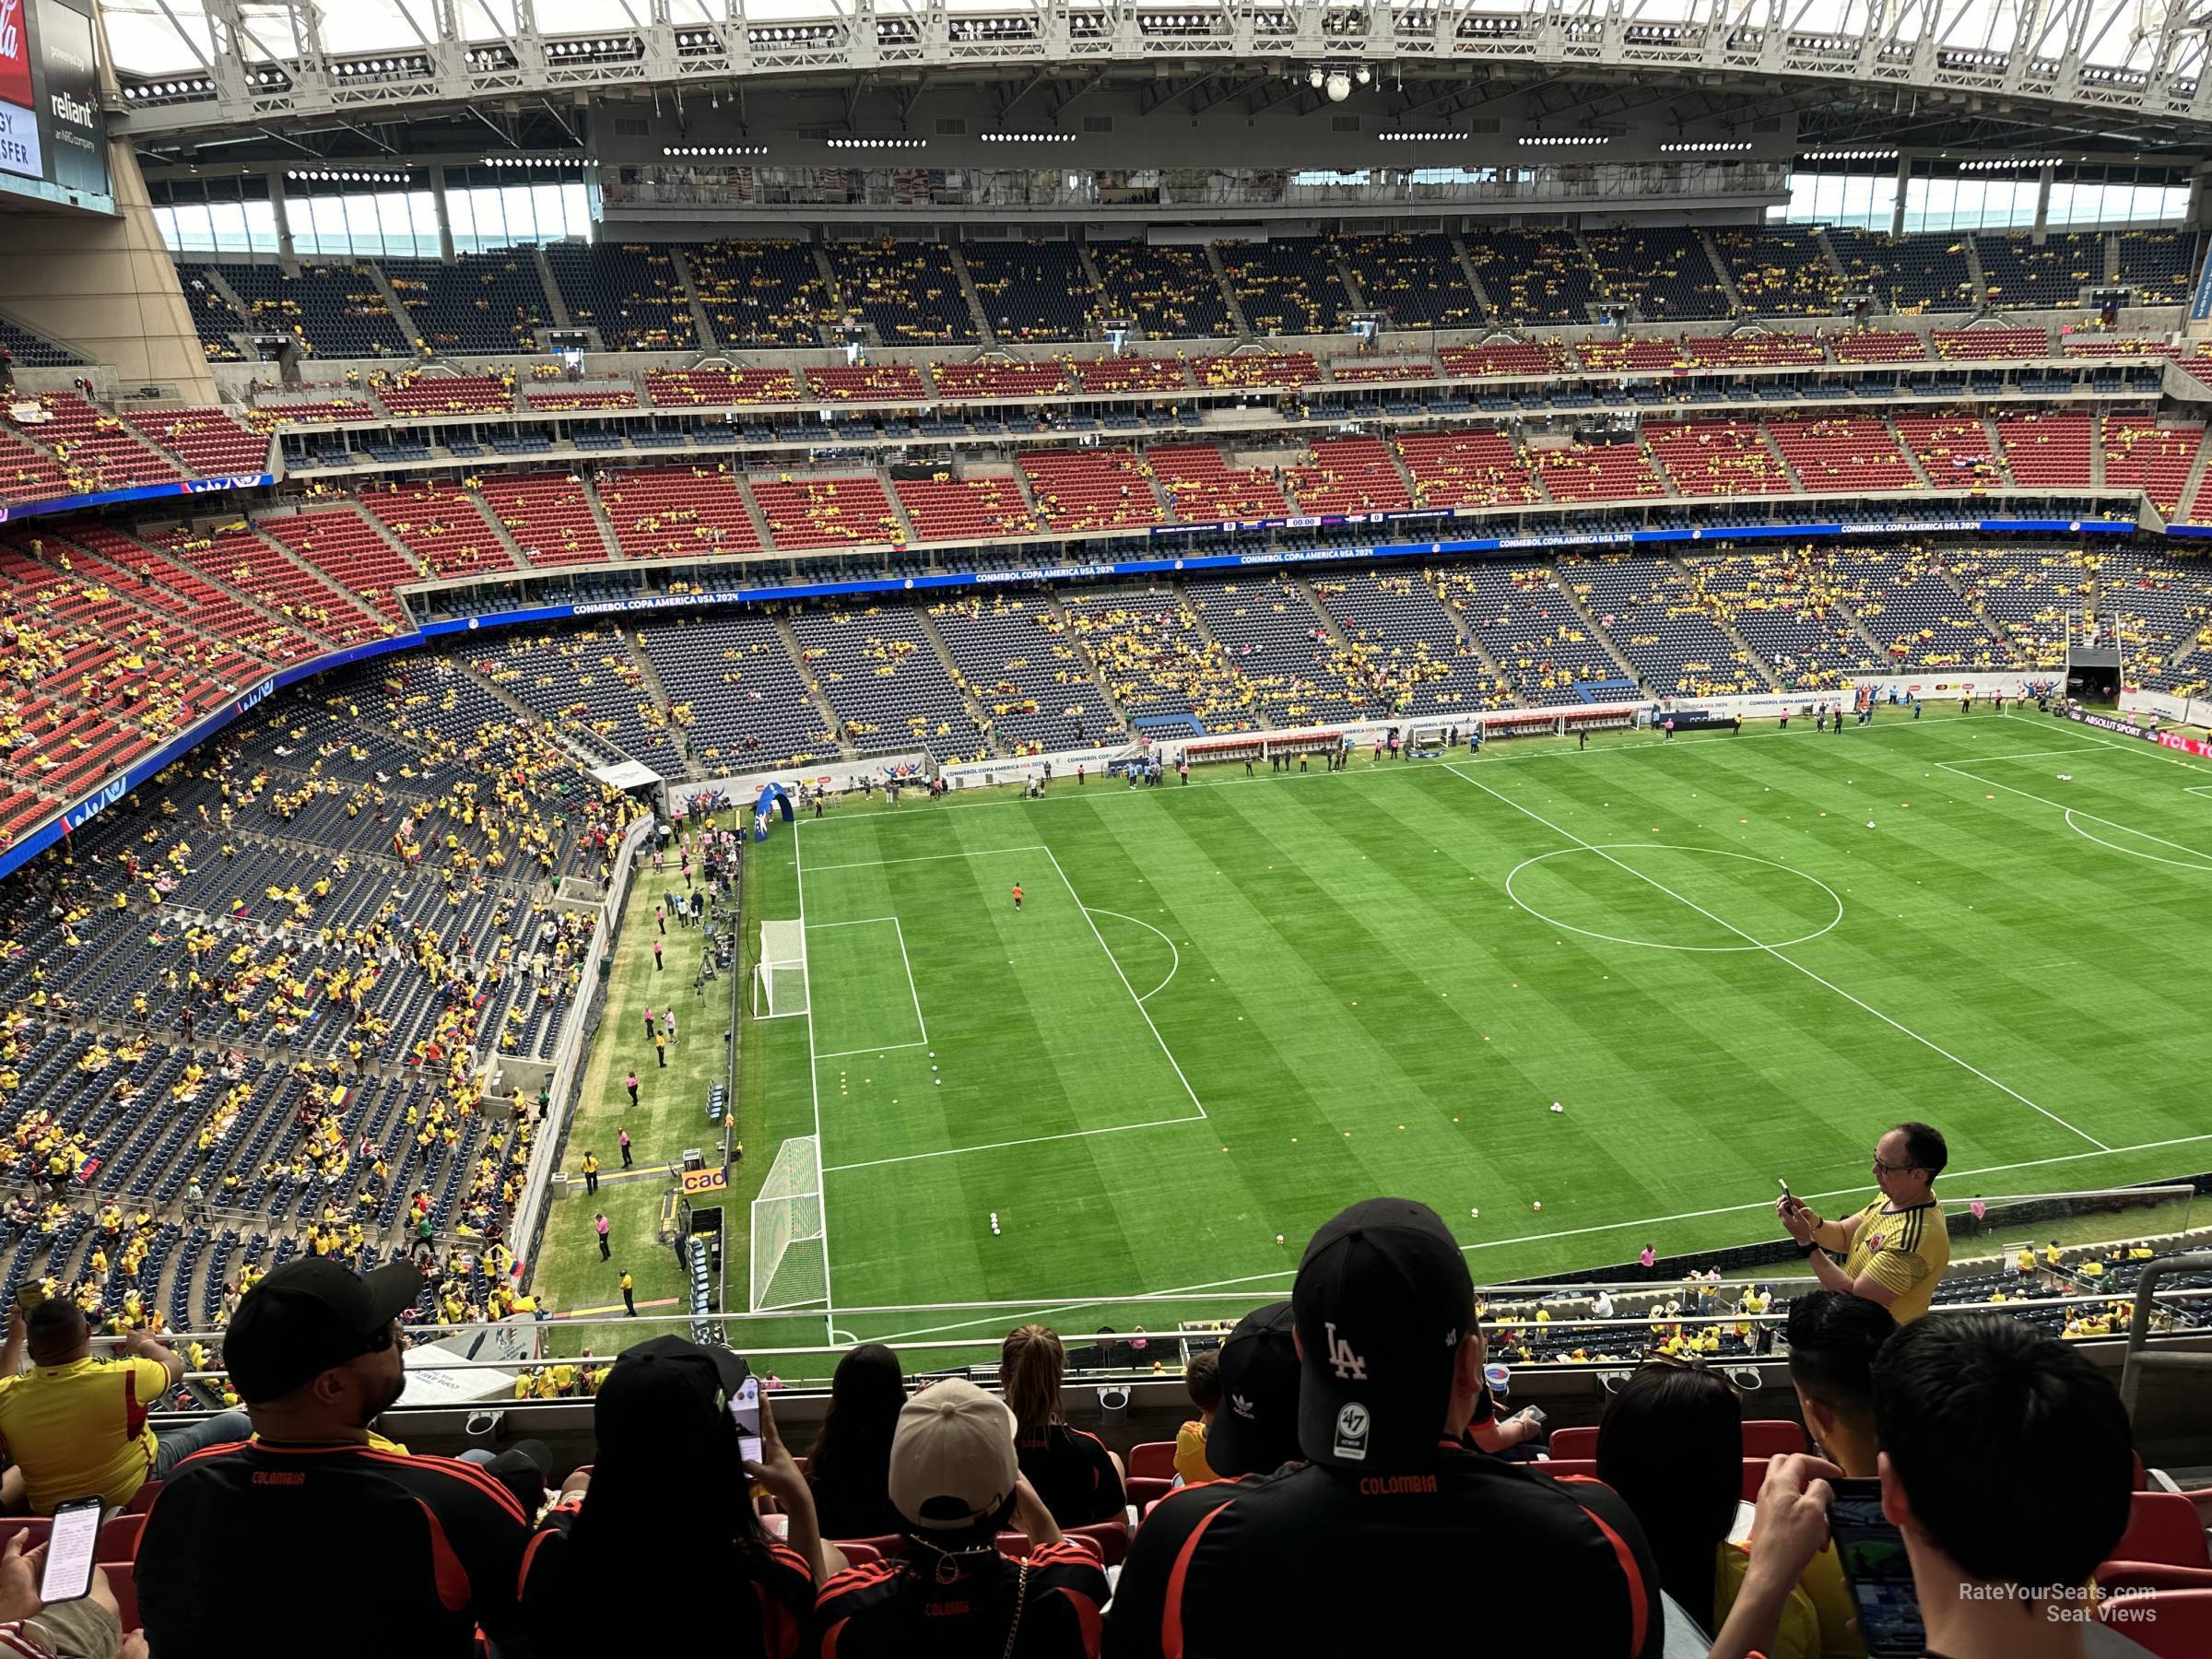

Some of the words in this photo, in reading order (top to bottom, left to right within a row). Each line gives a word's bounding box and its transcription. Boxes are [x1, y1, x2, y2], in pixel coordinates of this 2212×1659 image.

[51, 46, 76, 65] powered
[51, 91, 93, 129] reliant
[0, 139, 29, 164] SFER
[62, 131, 73, 144] NRG
[73, 138, 95, 153] company
[1841, 524, 1885, 533] CONMEBOL
[1886, 523, 1908, 532] COPA
[1908, 522, 1943, 531] AMERICA
[1944, 522, 1959, 531] USA
[1960, 522, 1982, 530] 2024
[1500, 538, 1542, 547] CONMEBOL
[1543, 537, 1564, 546] COPA
[1564, 535, 1598, 545] AMERICA
[1599, 535, 1613, 543] USA
[1614, 534, 1633, 542] 2024
[1241, 553, 1283, 564] CONMEBOL
[1284, 552, 1305, 562] COPA
[1305, 550, 1338, 560] AMERICA
[1339, 548, 1354, 558] USA
[1355, 547, 1373, 557] 2024
[976, 572, 1021, 582] CONMEBOL
[1022, 571, 1043, 581] COPA
[1044, 568, 1079, 578] AMERICA
[1080, 567, 1095, 576] USA
[1096, 565, 1115, 574] 2024
[573, 603, 627, 615] CONMEBOL
[628, 600, 654, 611] COPA
[655, 597, 696, 608] AMERICA
[698, 594, 716, 605] USA
[716, 593, 739, 602] 2024
[2085, 714, 2117, 730] ABSOLUT
[2117, 723, 2141, 736] SPORT
[2159, 732, 2190, 752] TCL
[947, 769, 978, 777] CONMEBOL
[994, 763, 1019, 771] AMERICA
[684, 1169, 726, 1190] cad
[1324, 1322, 1368, 1380] LA
[251, 1471, 306, 1485] COLOMBIA
[1360, 1475, 1438, 1495] COLOMBIA
